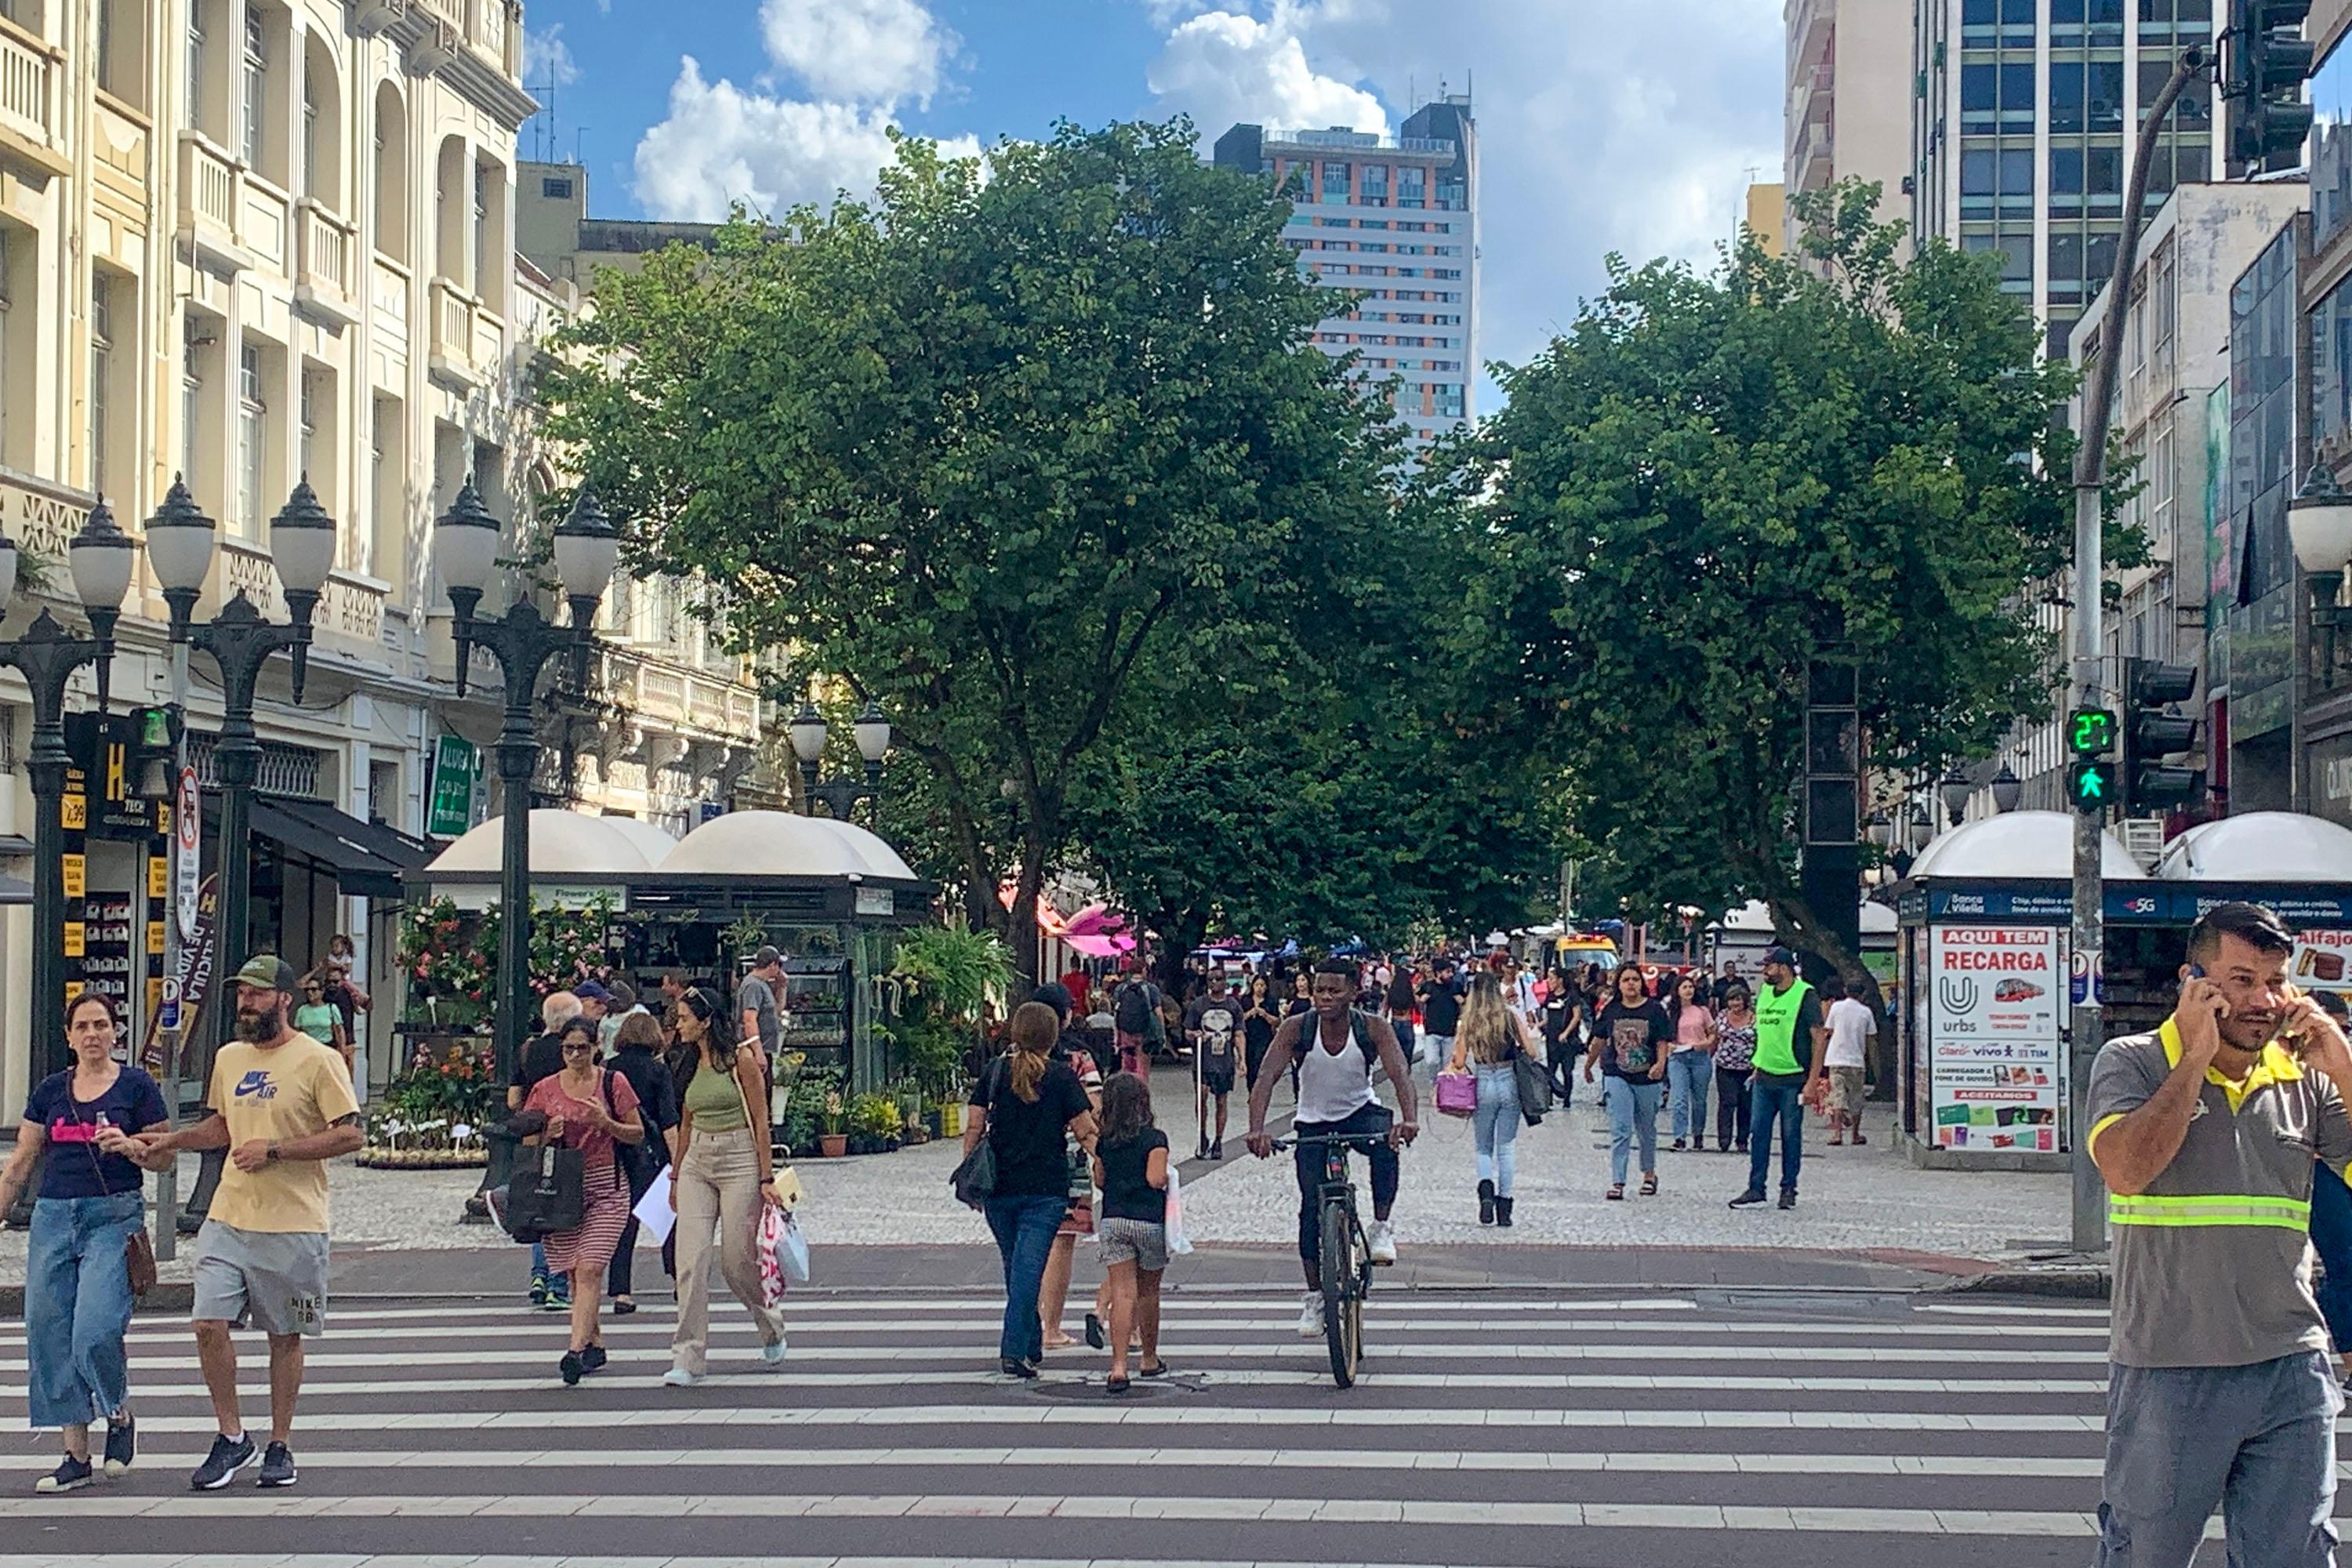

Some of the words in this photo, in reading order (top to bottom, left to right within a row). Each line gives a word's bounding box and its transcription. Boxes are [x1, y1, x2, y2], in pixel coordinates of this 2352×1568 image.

[2075, 714, 2109, 750] 27
[1951, 894, 1984, 904] Banca
[2135, 898, 2156, 913] 5G
[1945, 931, 1998, 944] AQUI
[2002, 931, 2045, 944] TEM
[2296, 929, 2352, 948] Alfajo
[185, 927, 215, 1001] ELICULA
[1944, 951, 2048, 971] RECARGA
[1943, 1018, 1977, 1033] urbs
[1938, 1044, 1968, 1056] Claro
[1973, 1046, 2002, 1057] vivo
[244, 1070, 271, 1085] NIKE
[257, 1085, 278, 1099] AIR
[1959, 1091, 2033, 1100] ACEITAMOS
[292, 1296, 321, 1309] NIKE
